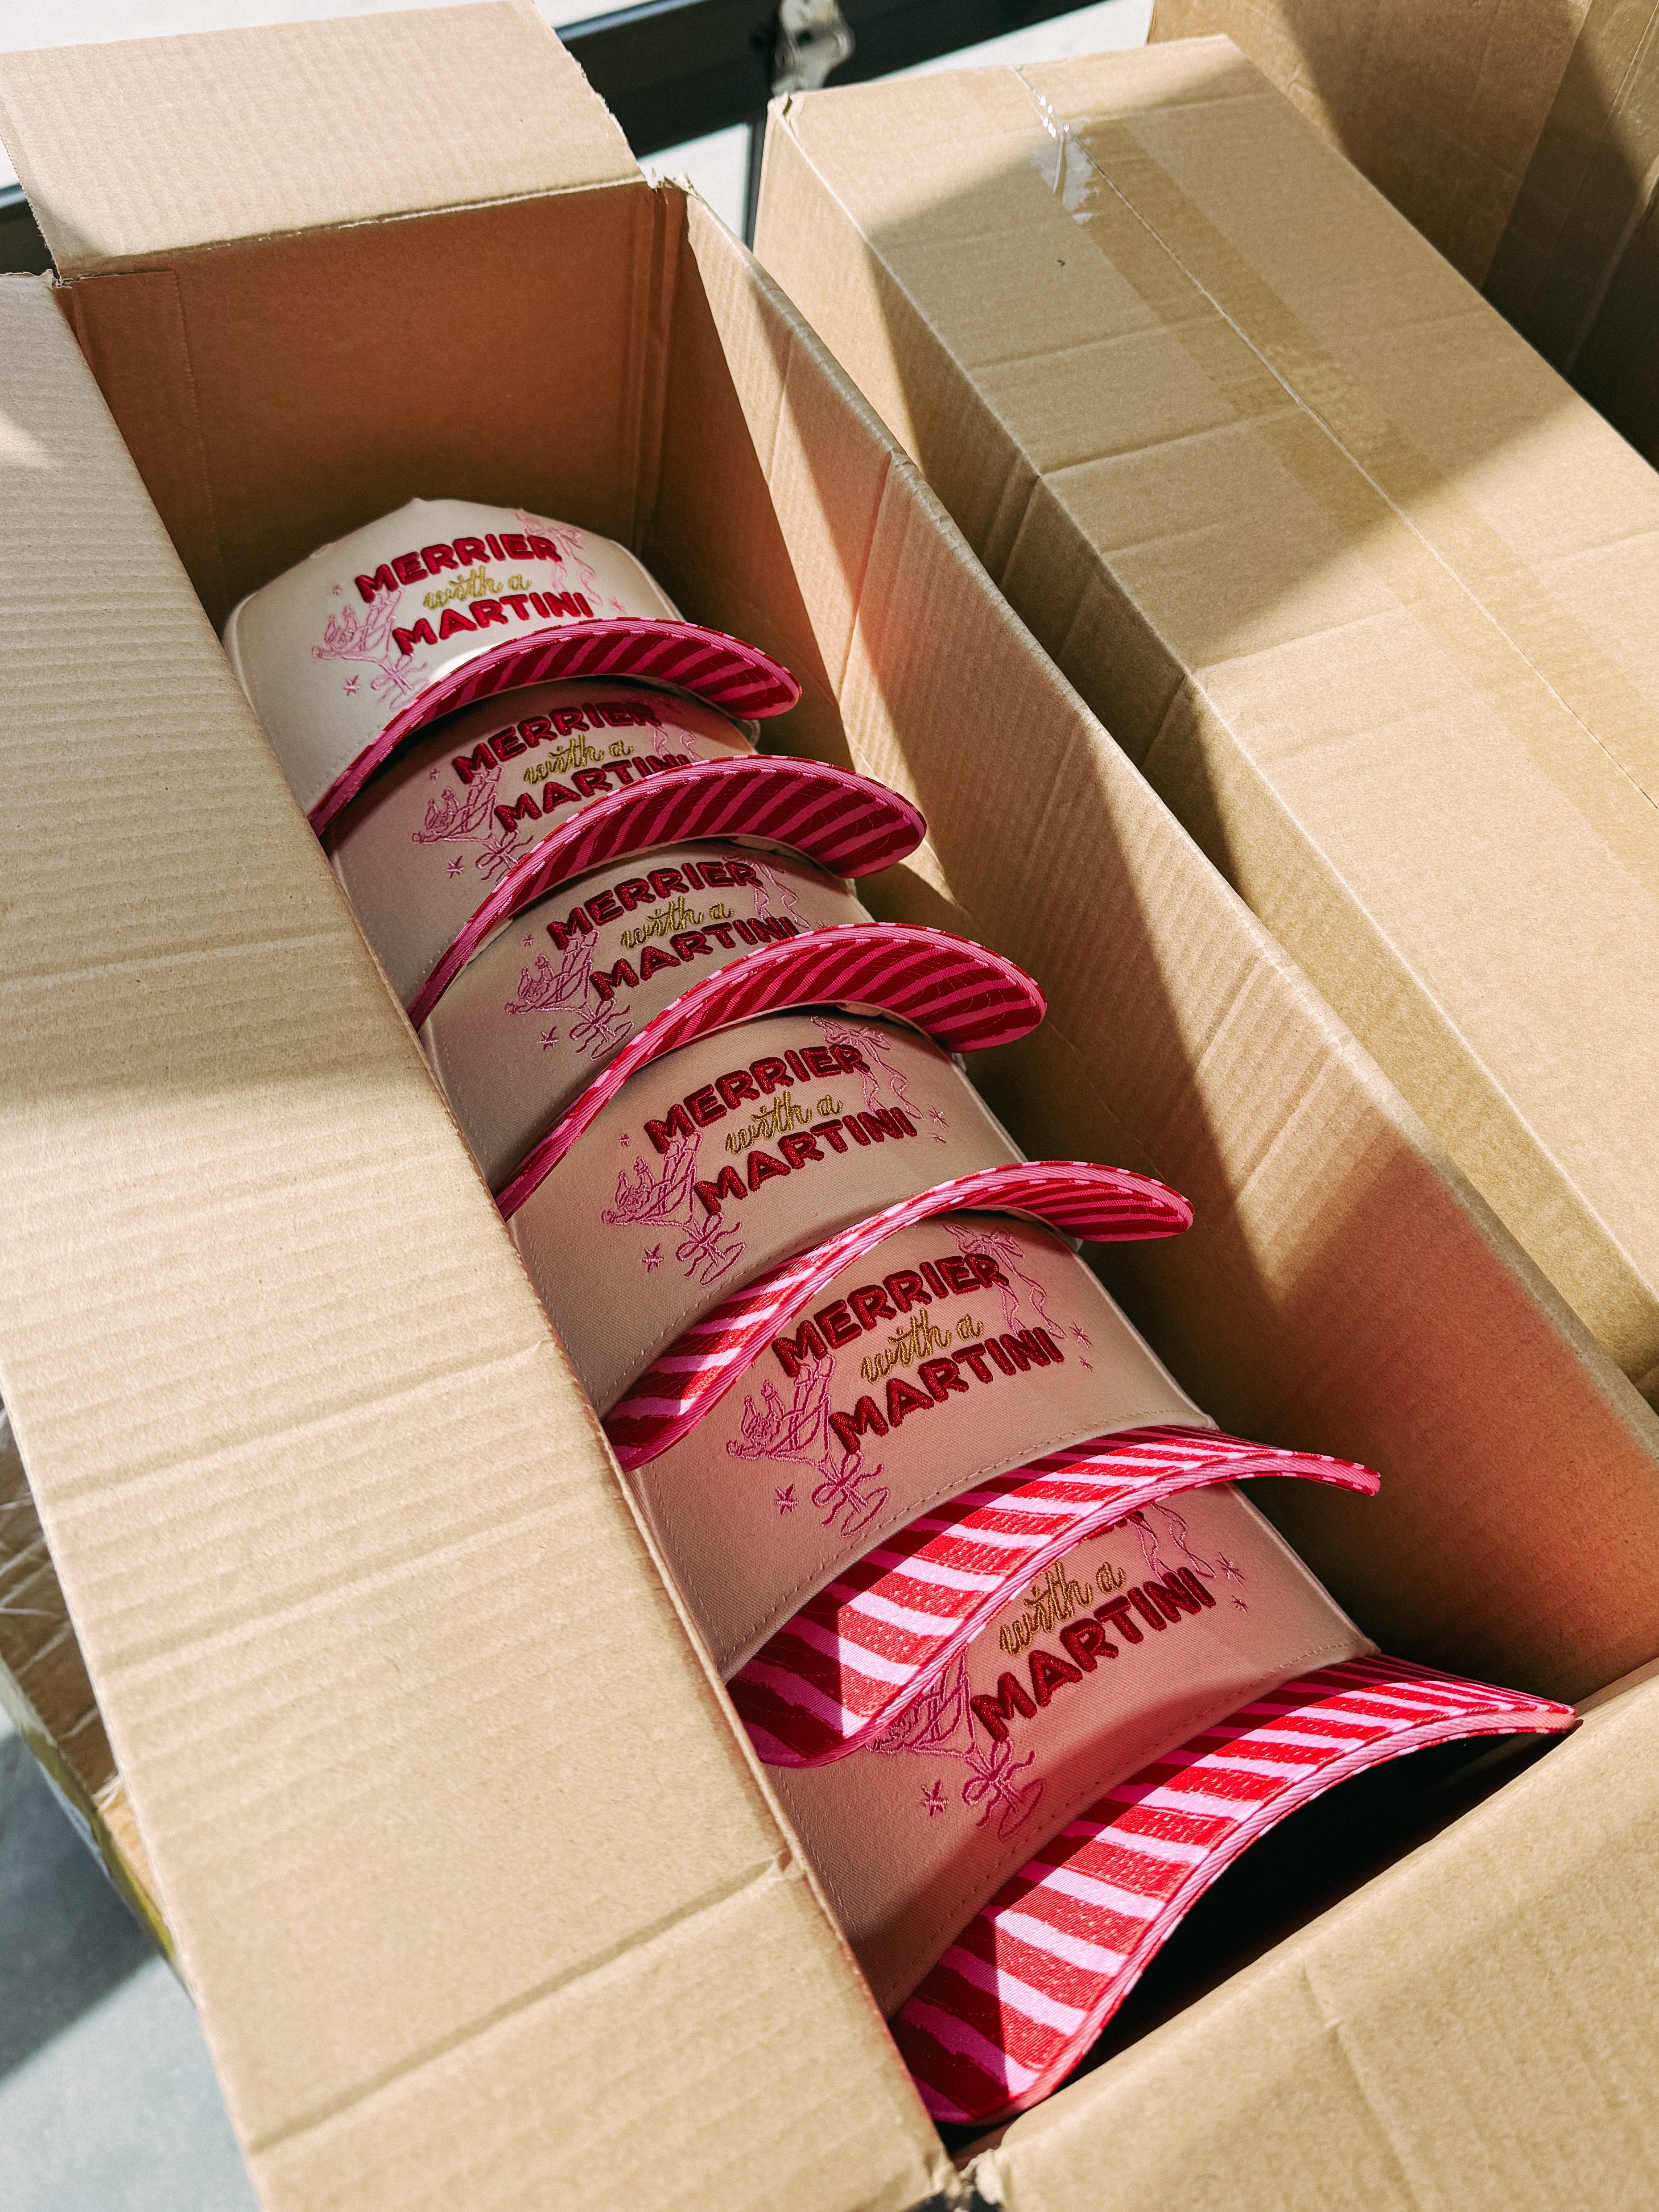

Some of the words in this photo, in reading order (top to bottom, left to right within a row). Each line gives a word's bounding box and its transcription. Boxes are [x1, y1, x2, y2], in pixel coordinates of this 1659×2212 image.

[355, 533, 562, 603] MERRIER
[424, 566, 503, 610] with
[508, 574, 531, 591] a
[392, 592, 594, 656] MARTINI
[451, 701, 662, 784] MERRIER
[524, 735, 604, 784] with
[609, 739, 634, 757] a
[546, 861, 763, 950] MERRIER
[620, 896, 704, 949] with
[709, 902, 734, 920] a
[590, 916, 802, 1001] MARTINI
[644, 1044, 870, 1154] MERRIER
[725, 1090, 812, 1155] with
[816, 1094, 842, 1117] a
[693, 1106, 917, 1215] MARTINI
[772, 1253, 1010, 1378] MERRIER
[861, 1308, 951, 1384] with
[956, 1313, 983, 1340] a
[829, 1327, 1065, 1454] MARTINI
[999, 1561, 1092, 1656] with
[1096, 1561, 1126, 1593] a
[970, 1567, 1216, 1740] MARTINI
